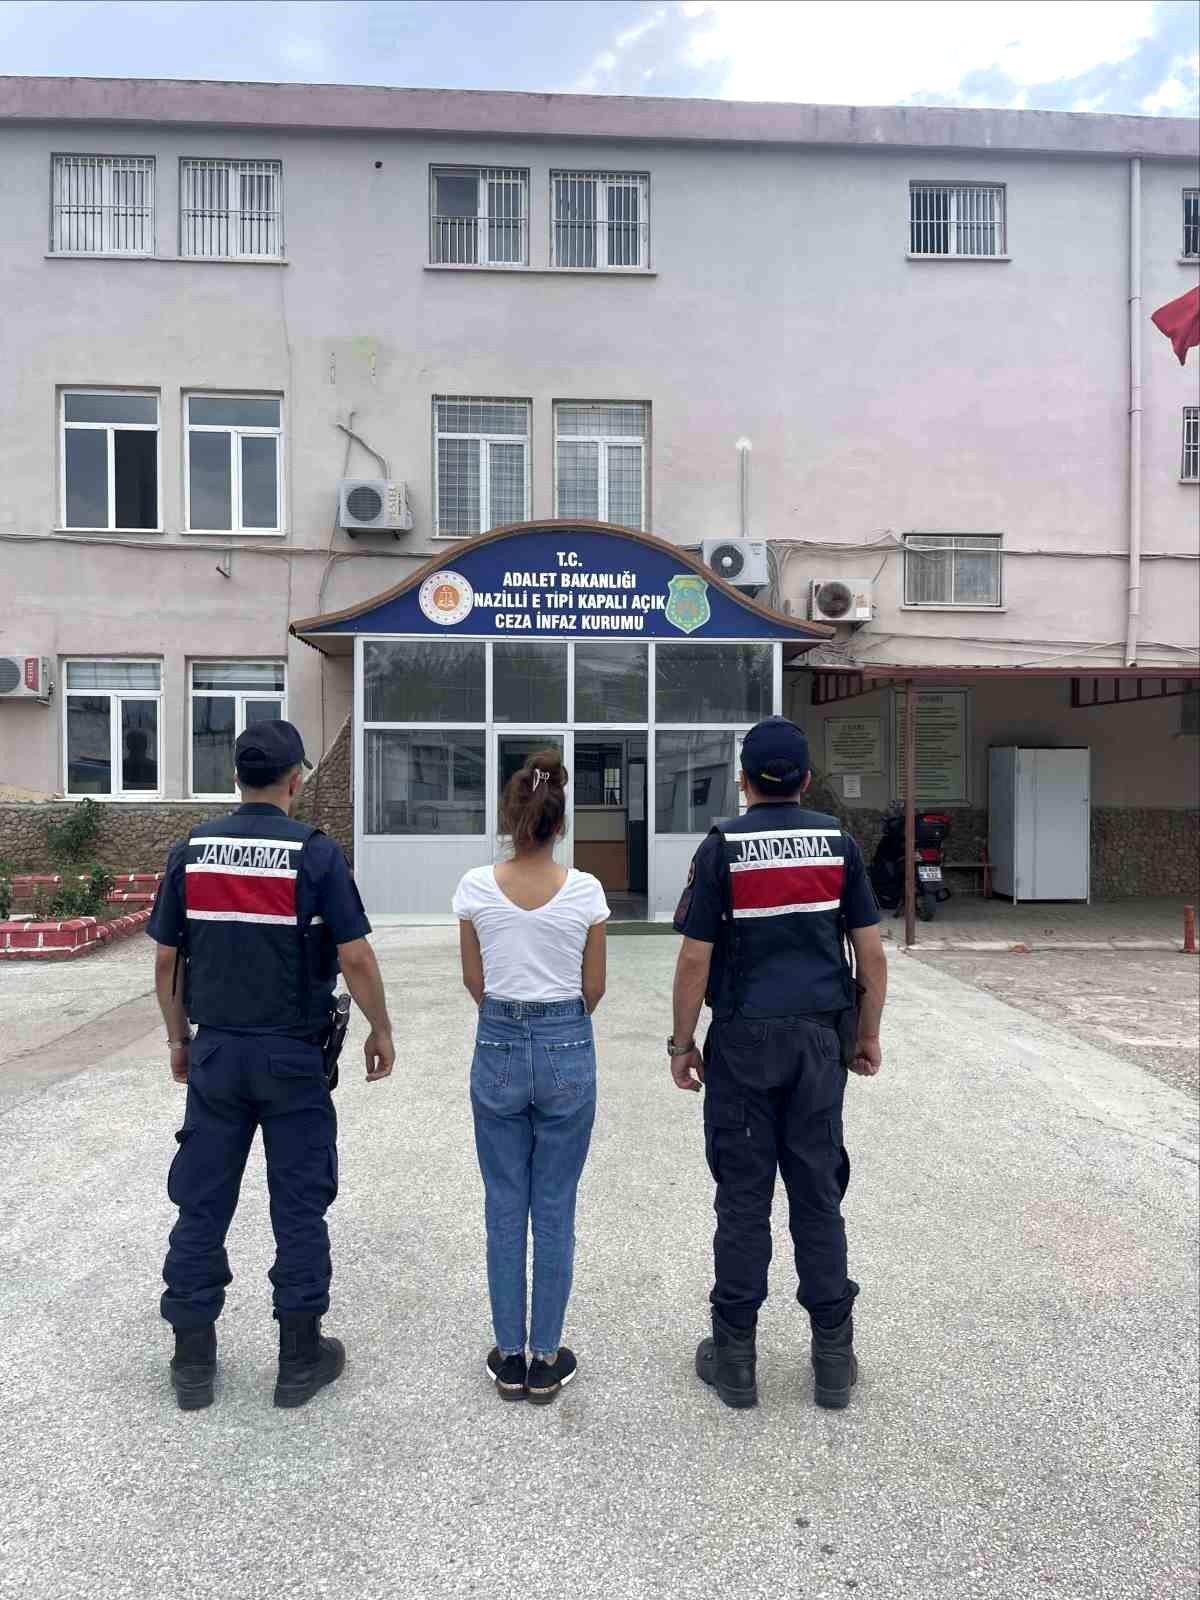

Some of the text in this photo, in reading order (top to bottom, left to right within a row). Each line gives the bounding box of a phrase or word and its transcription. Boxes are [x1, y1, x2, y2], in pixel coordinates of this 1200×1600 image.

[556, 551, 583, 567] T.C.
[503, 570, 637, 589] ADALET BAKANLIĞI
[474, 589, 666, 614] NAZİLLİ E TİPİ KAPALI AÇIK
[495, 611, 644, 631] CEZA İNFAZ KURUMU
[196, 844, 291, 869] JANDARMA
[737, 836, 833, 861] JANDARMA
